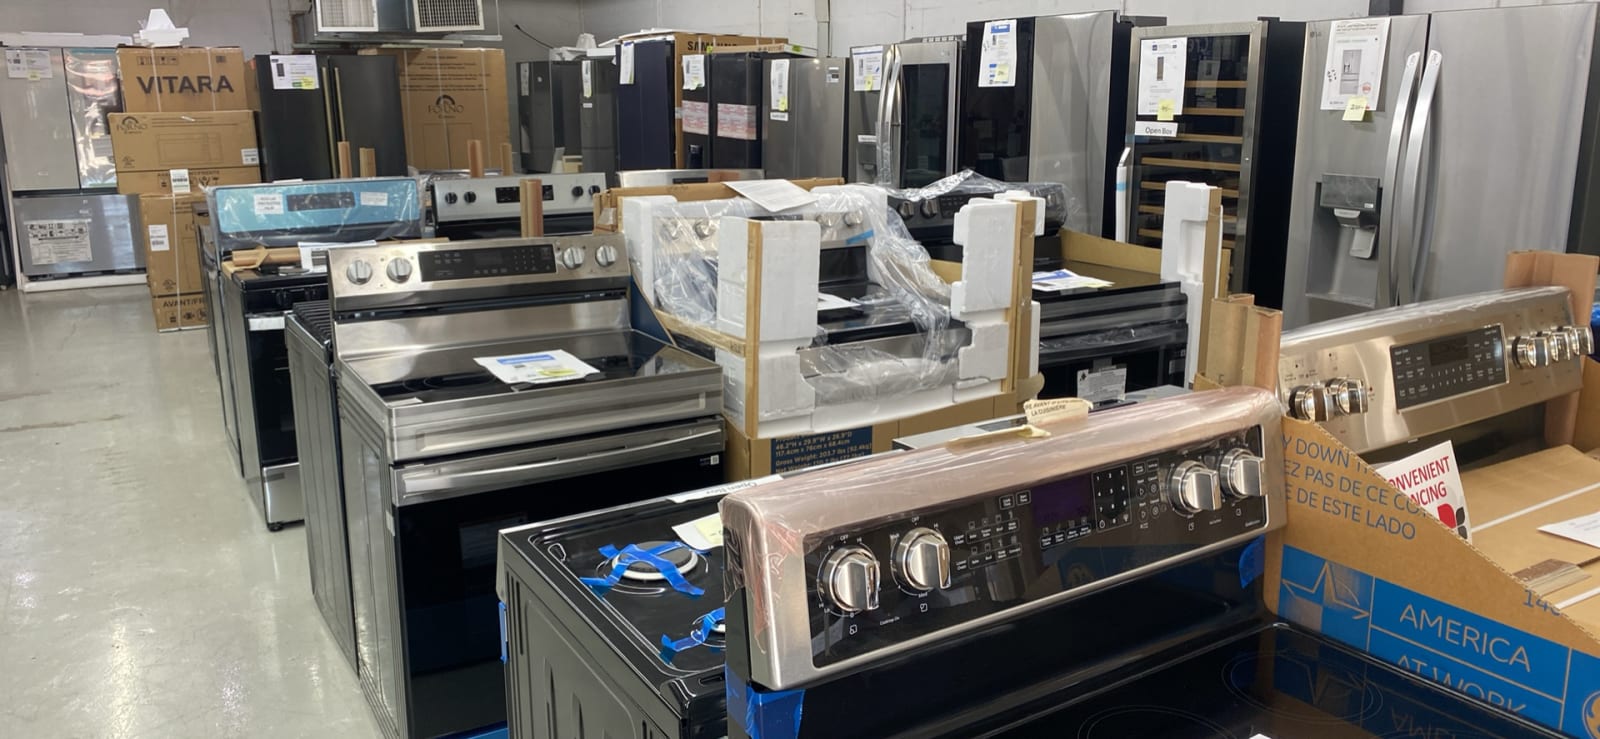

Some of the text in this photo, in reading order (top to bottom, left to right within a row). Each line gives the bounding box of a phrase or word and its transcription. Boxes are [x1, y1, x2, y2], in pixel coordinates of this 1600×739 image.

[136, 75, 234, 94] VITARA
[1145, 126, 1173, 135] Open Box
[1296, 438, 1349, 469] DOWN
[1305, 465, 1335, 488] PAS
[1340, 476, 1361, 497] DE
[1366, 485, 1389, 506] CE
[1389, 456, 1451, 493] ONVENIENT
[1410, 481, 1448, 507] NCING
[1297, 487, 1318, 509] DE
[1322, 495, 1361, 523] ESTE
[1366, 509, 1416, 540] LADO
[1400, 603, 1531, 673] AMERICA
